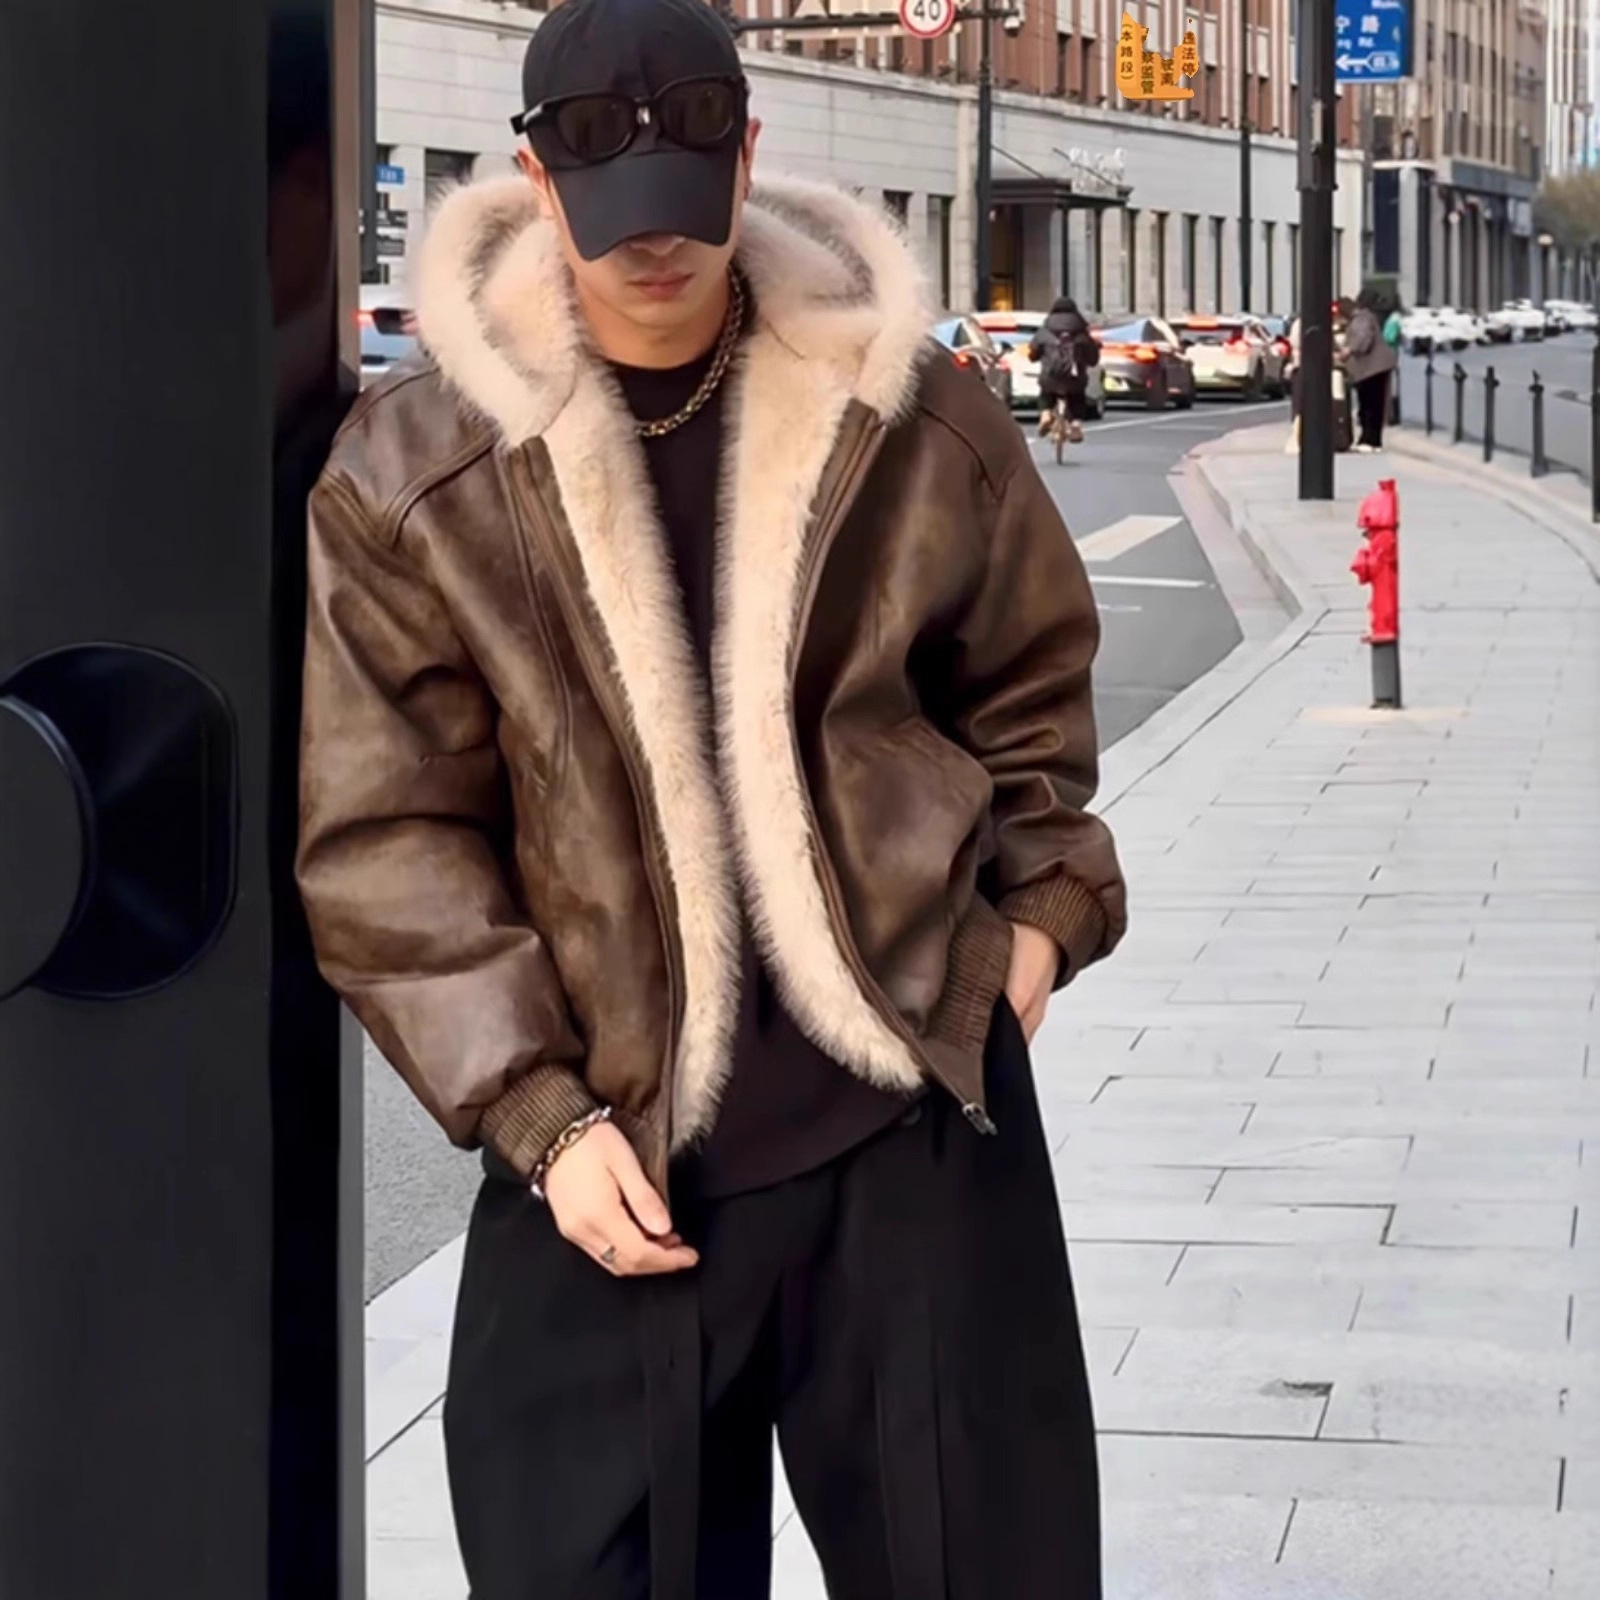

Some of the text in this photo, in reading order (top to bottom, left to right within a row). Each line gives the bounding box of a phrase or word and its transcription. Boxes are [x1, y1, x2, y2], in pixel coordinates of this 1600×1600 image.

[913, 0, 941, 21] 40
[1142, 33, 1154, 94] 察监管
